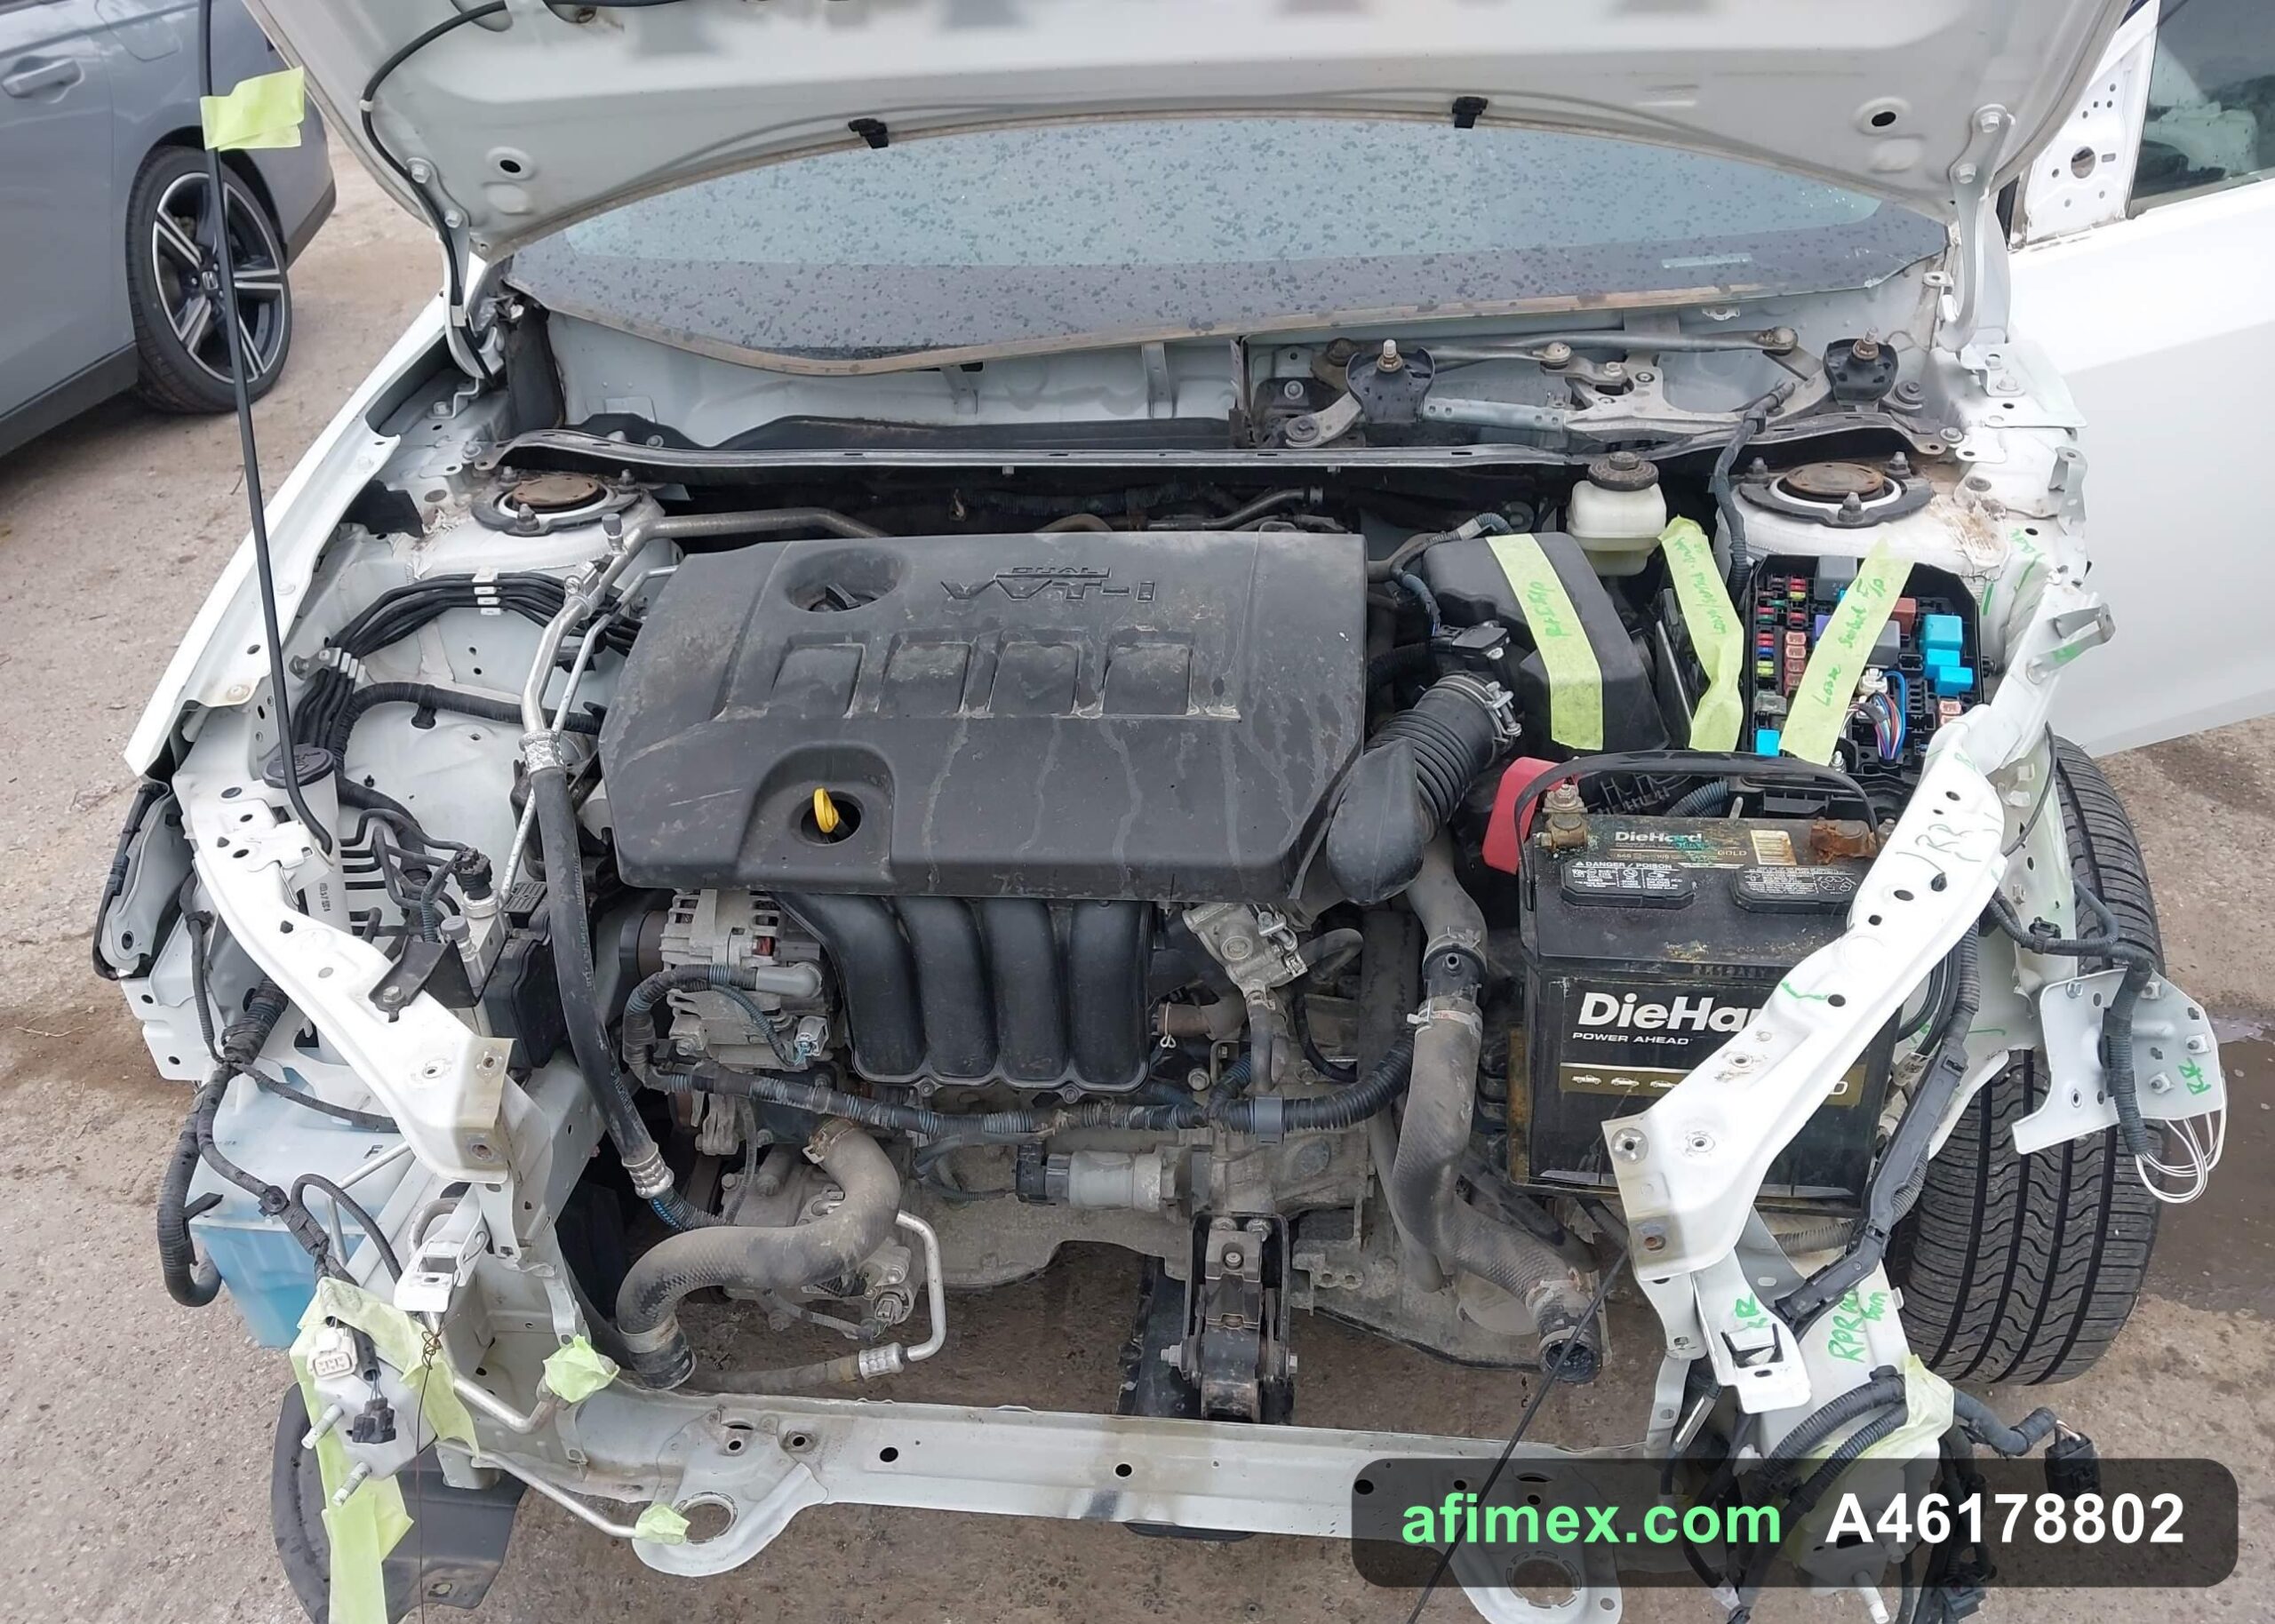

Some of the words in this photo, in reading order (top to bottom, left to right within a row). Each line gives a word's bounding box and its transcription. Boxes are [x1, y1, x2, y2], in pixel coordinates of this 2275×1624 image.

[1578, 991, 1764, 1032] DieHa
[1572, 1031, 1629, 1043] POWER
[1632, 1037, 1689, 1046] AHEAD
